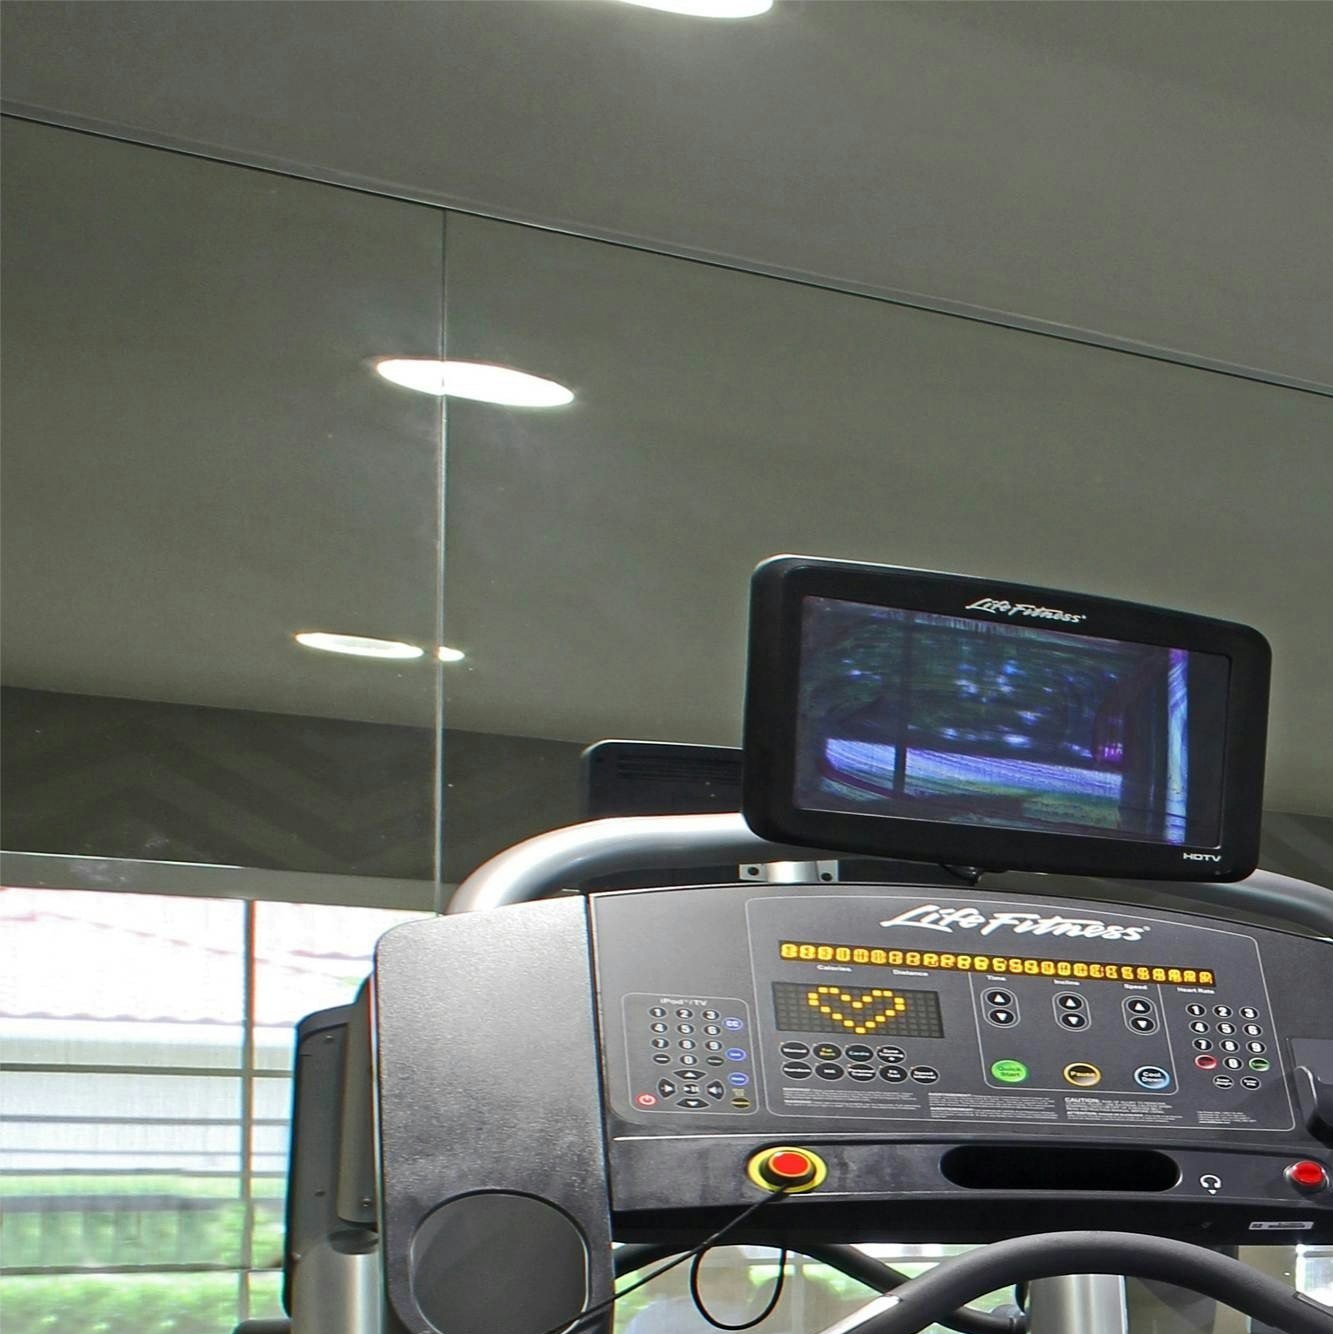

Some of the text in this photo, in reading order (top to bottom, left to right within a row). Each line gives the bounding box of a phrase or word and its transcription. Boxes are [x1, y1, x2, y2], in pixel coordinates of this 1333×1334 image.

[1183, 852, 1221, 862] HDTV
[1191, 1005, 1255, 1018] 1 2 3
[1194, 1022, 1205, 1032] 4
[1221, 1024, 1232, 1034] 5
[1198, 1040, 1207, 1050] 7
[1252, 1042, 1262, 1053] 9
